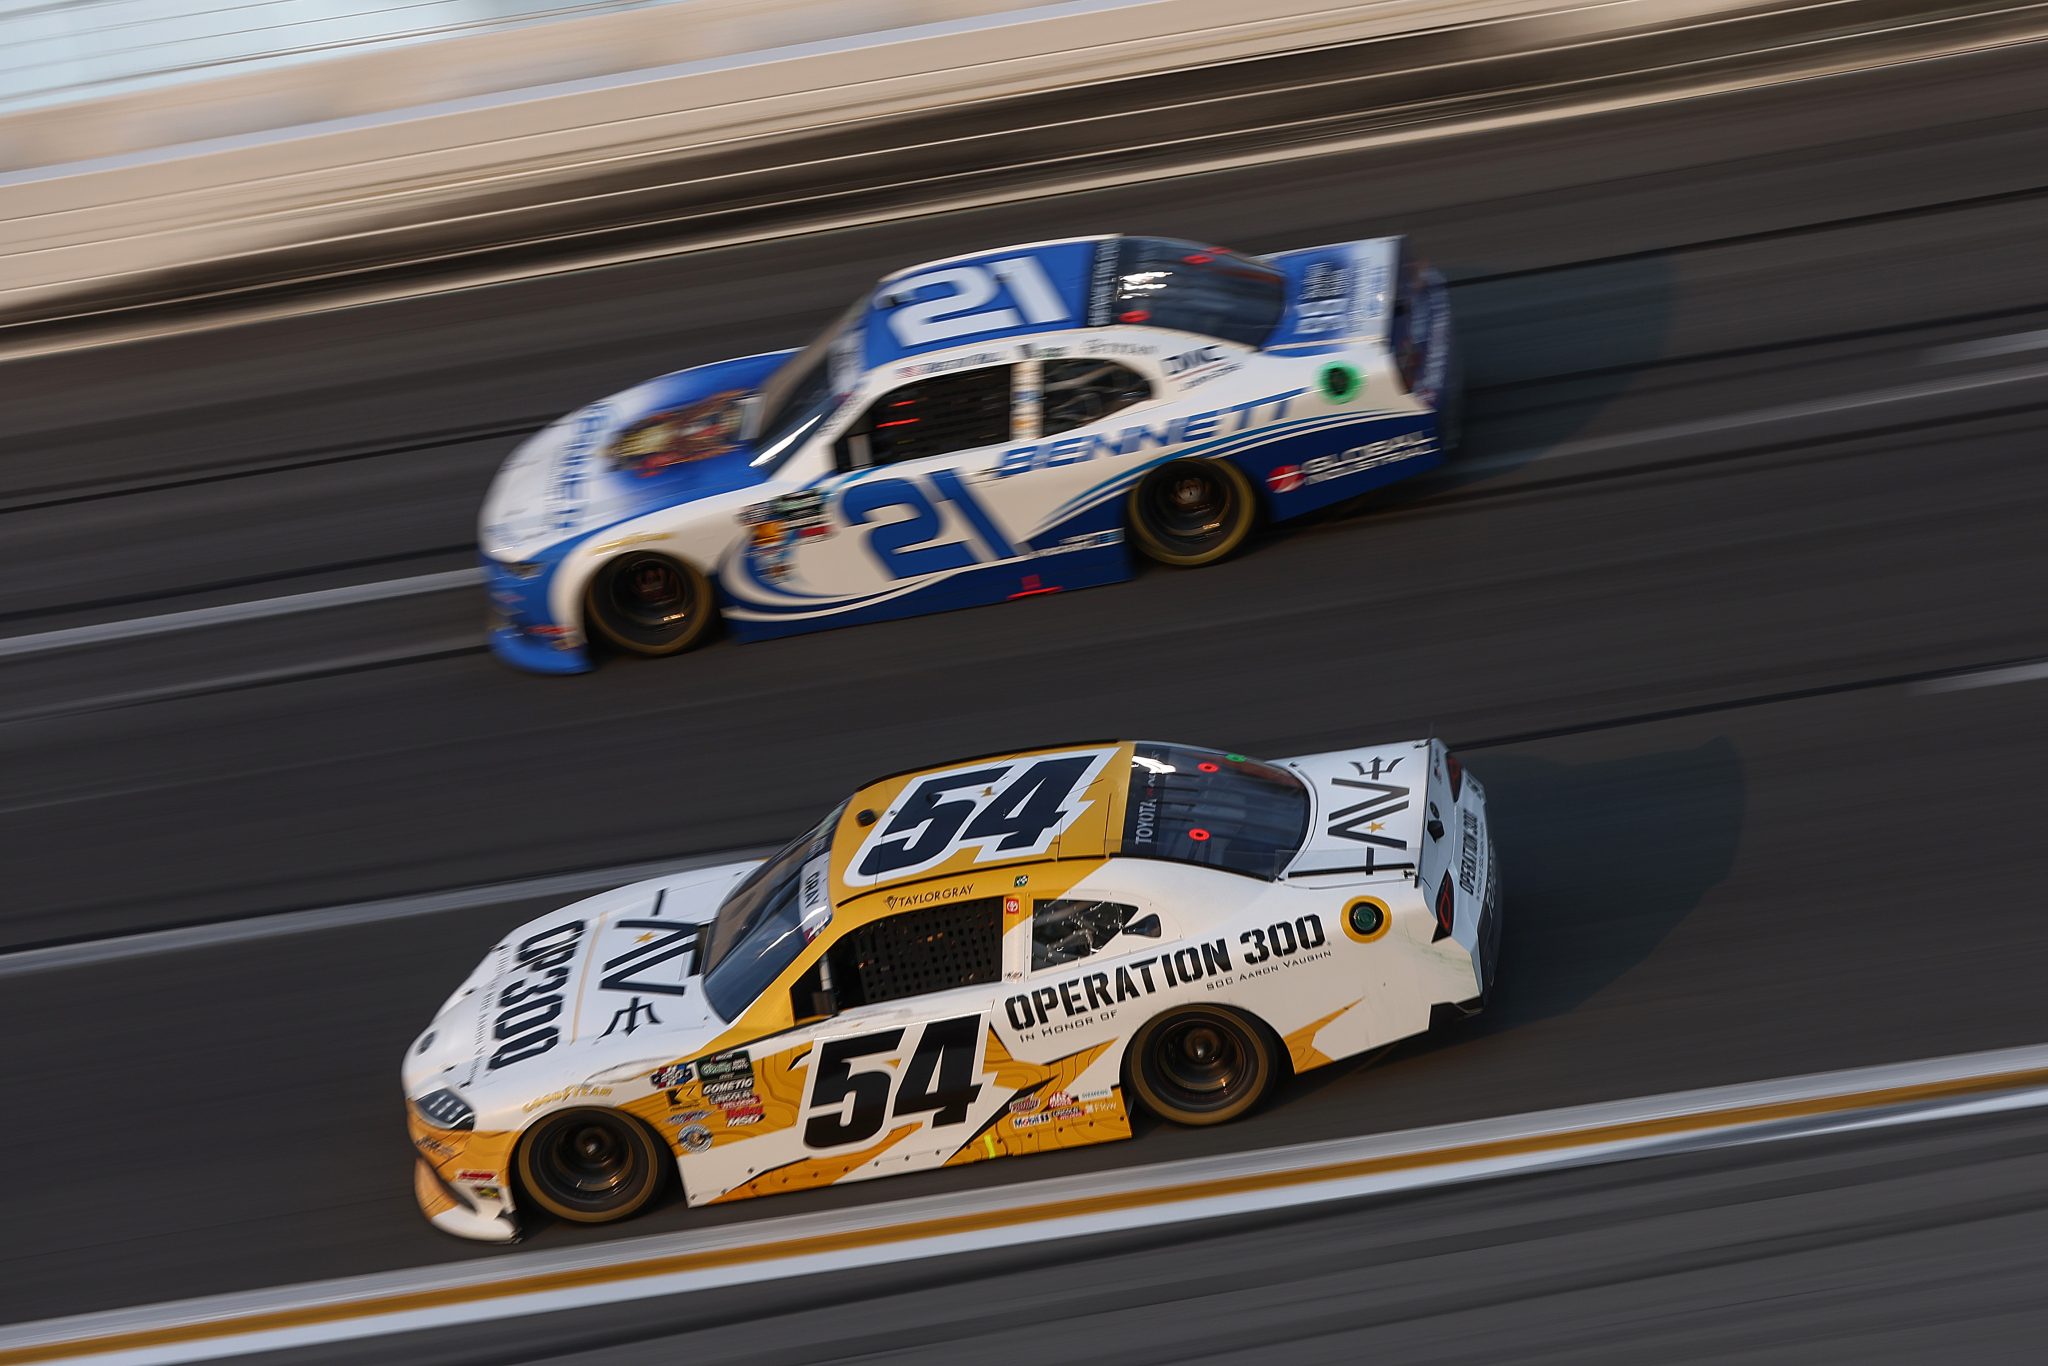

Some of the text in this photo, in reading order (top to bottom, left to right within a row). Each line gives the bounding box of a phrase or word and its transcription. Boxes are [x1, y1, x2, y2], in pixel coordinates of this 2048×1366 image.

[873, 255, 1072, 348] 21
[997, 386, 1309, 478] BENNETT
[840, 468, 1020, 581] 21
[857, 754, 1099, 876] 54
[1135, 798, 1157, 845] TOYOTA
[804, 870, 820, 909] GRAY
[899, 882, 975, 907] TAYLOR GRAY
[1004, 913, 1326, 1031] OPERATION 300
[1019, 1032, 1035, 1043] IN
[1042, 1017, 1094, 1037] HONOR
[1100, 1009, 1118, 1021] OF
[1239, 964, 1279, 981] AARON
[1282, 949, 1332, 969] VAUGHN
[804, 1013, 983, 1148] 54
